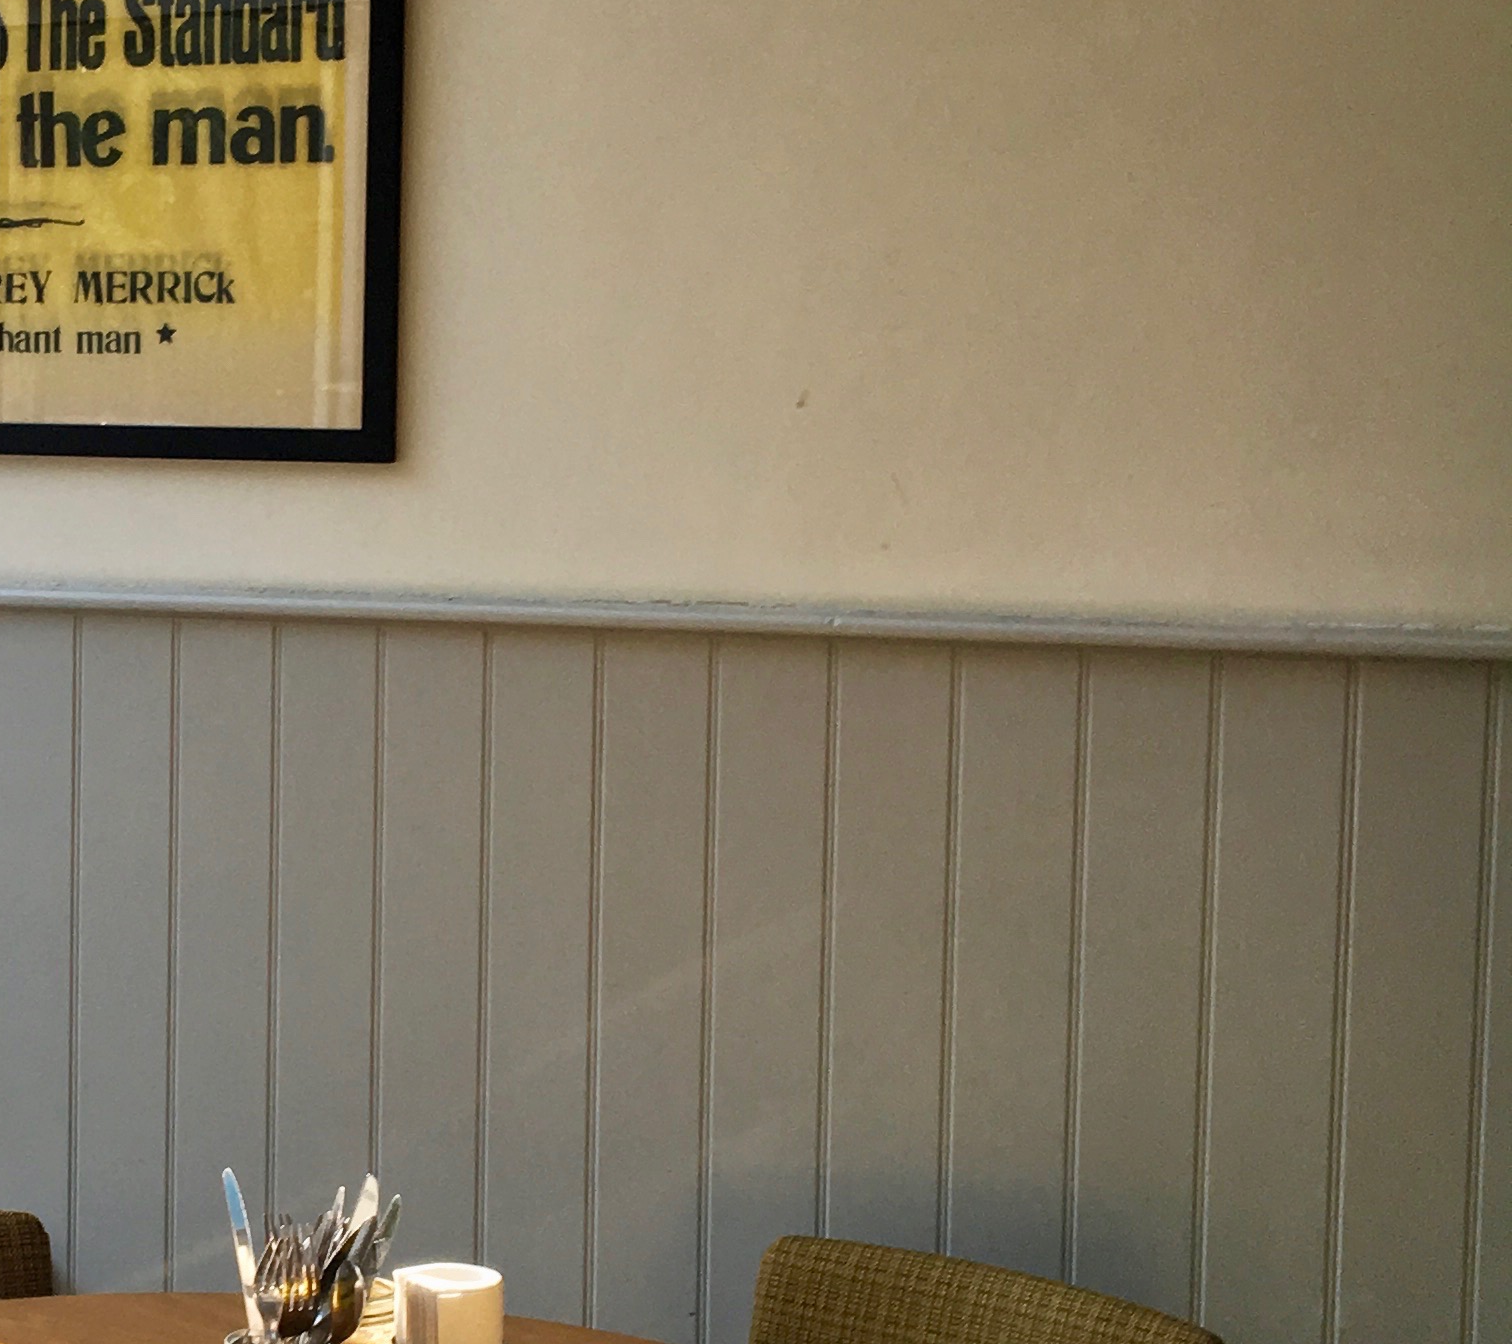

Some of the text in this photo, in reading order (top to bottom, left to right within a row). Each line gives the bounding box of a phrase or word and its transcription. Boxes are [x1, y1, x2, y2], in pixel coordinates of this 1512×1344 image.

[16, 90, 126, 169] the
[151, 102, 335, 166] man.
[73, 270, 235, 305] MERRICK
[77, 329, 142, 355] man
